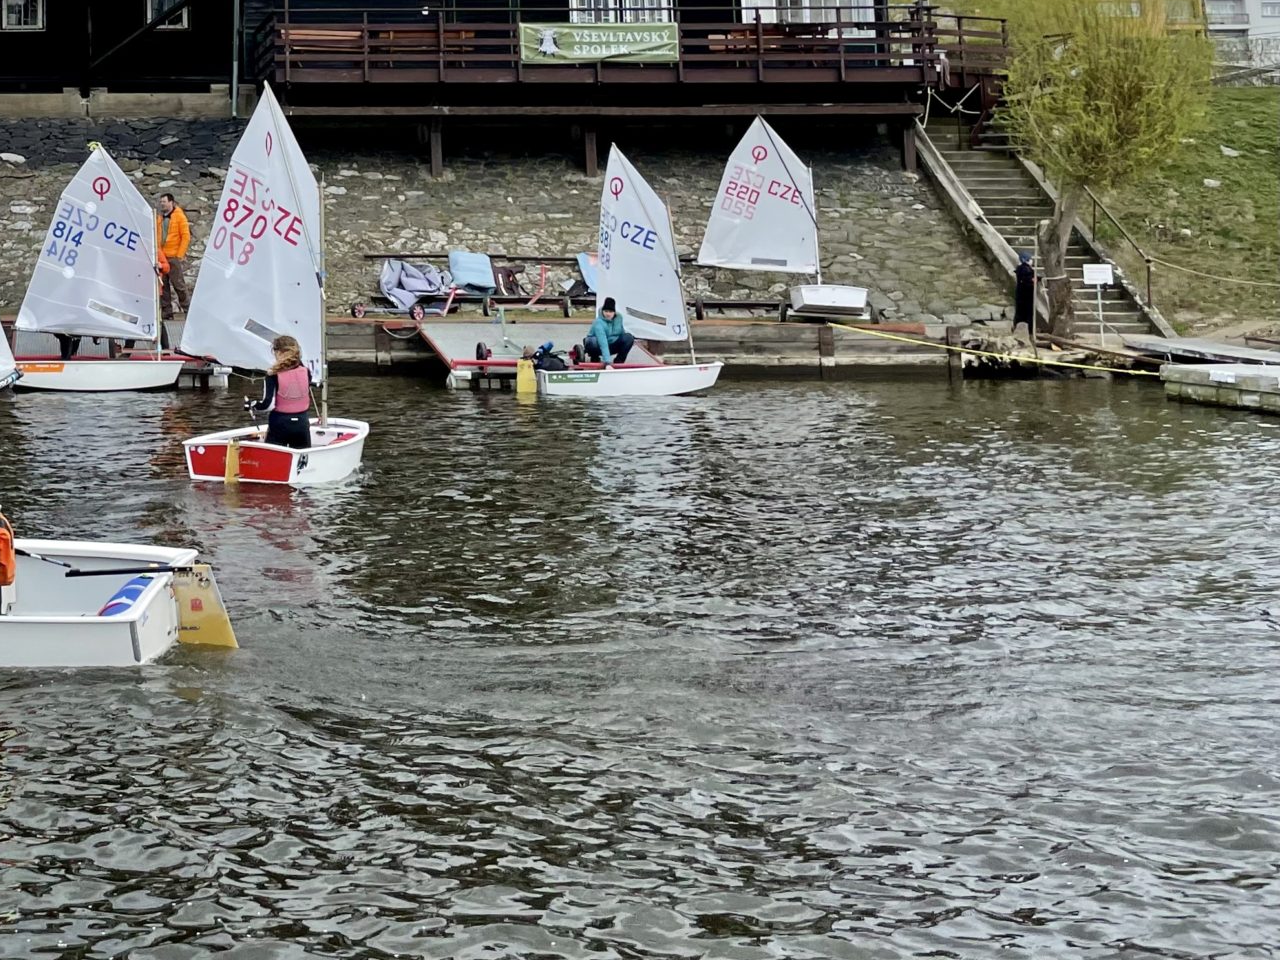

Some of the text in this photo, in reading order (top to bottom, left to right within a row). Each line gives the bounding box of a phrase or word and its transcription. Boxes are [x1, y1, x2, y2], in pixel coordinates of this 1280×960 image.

[573, 29, 671, 43] VŠEVLTAVSKÝ
[573, 44, 631, 56] SPOLEK
[725, 181, 761, 206] 220
[767, 180, 803, 205] CZE
[223, 198, 269, 240] 870
[52, 220, 85, 248] 814
[103, 221, 141, 252] CZE
[620, 220, 659, 251] CZE
